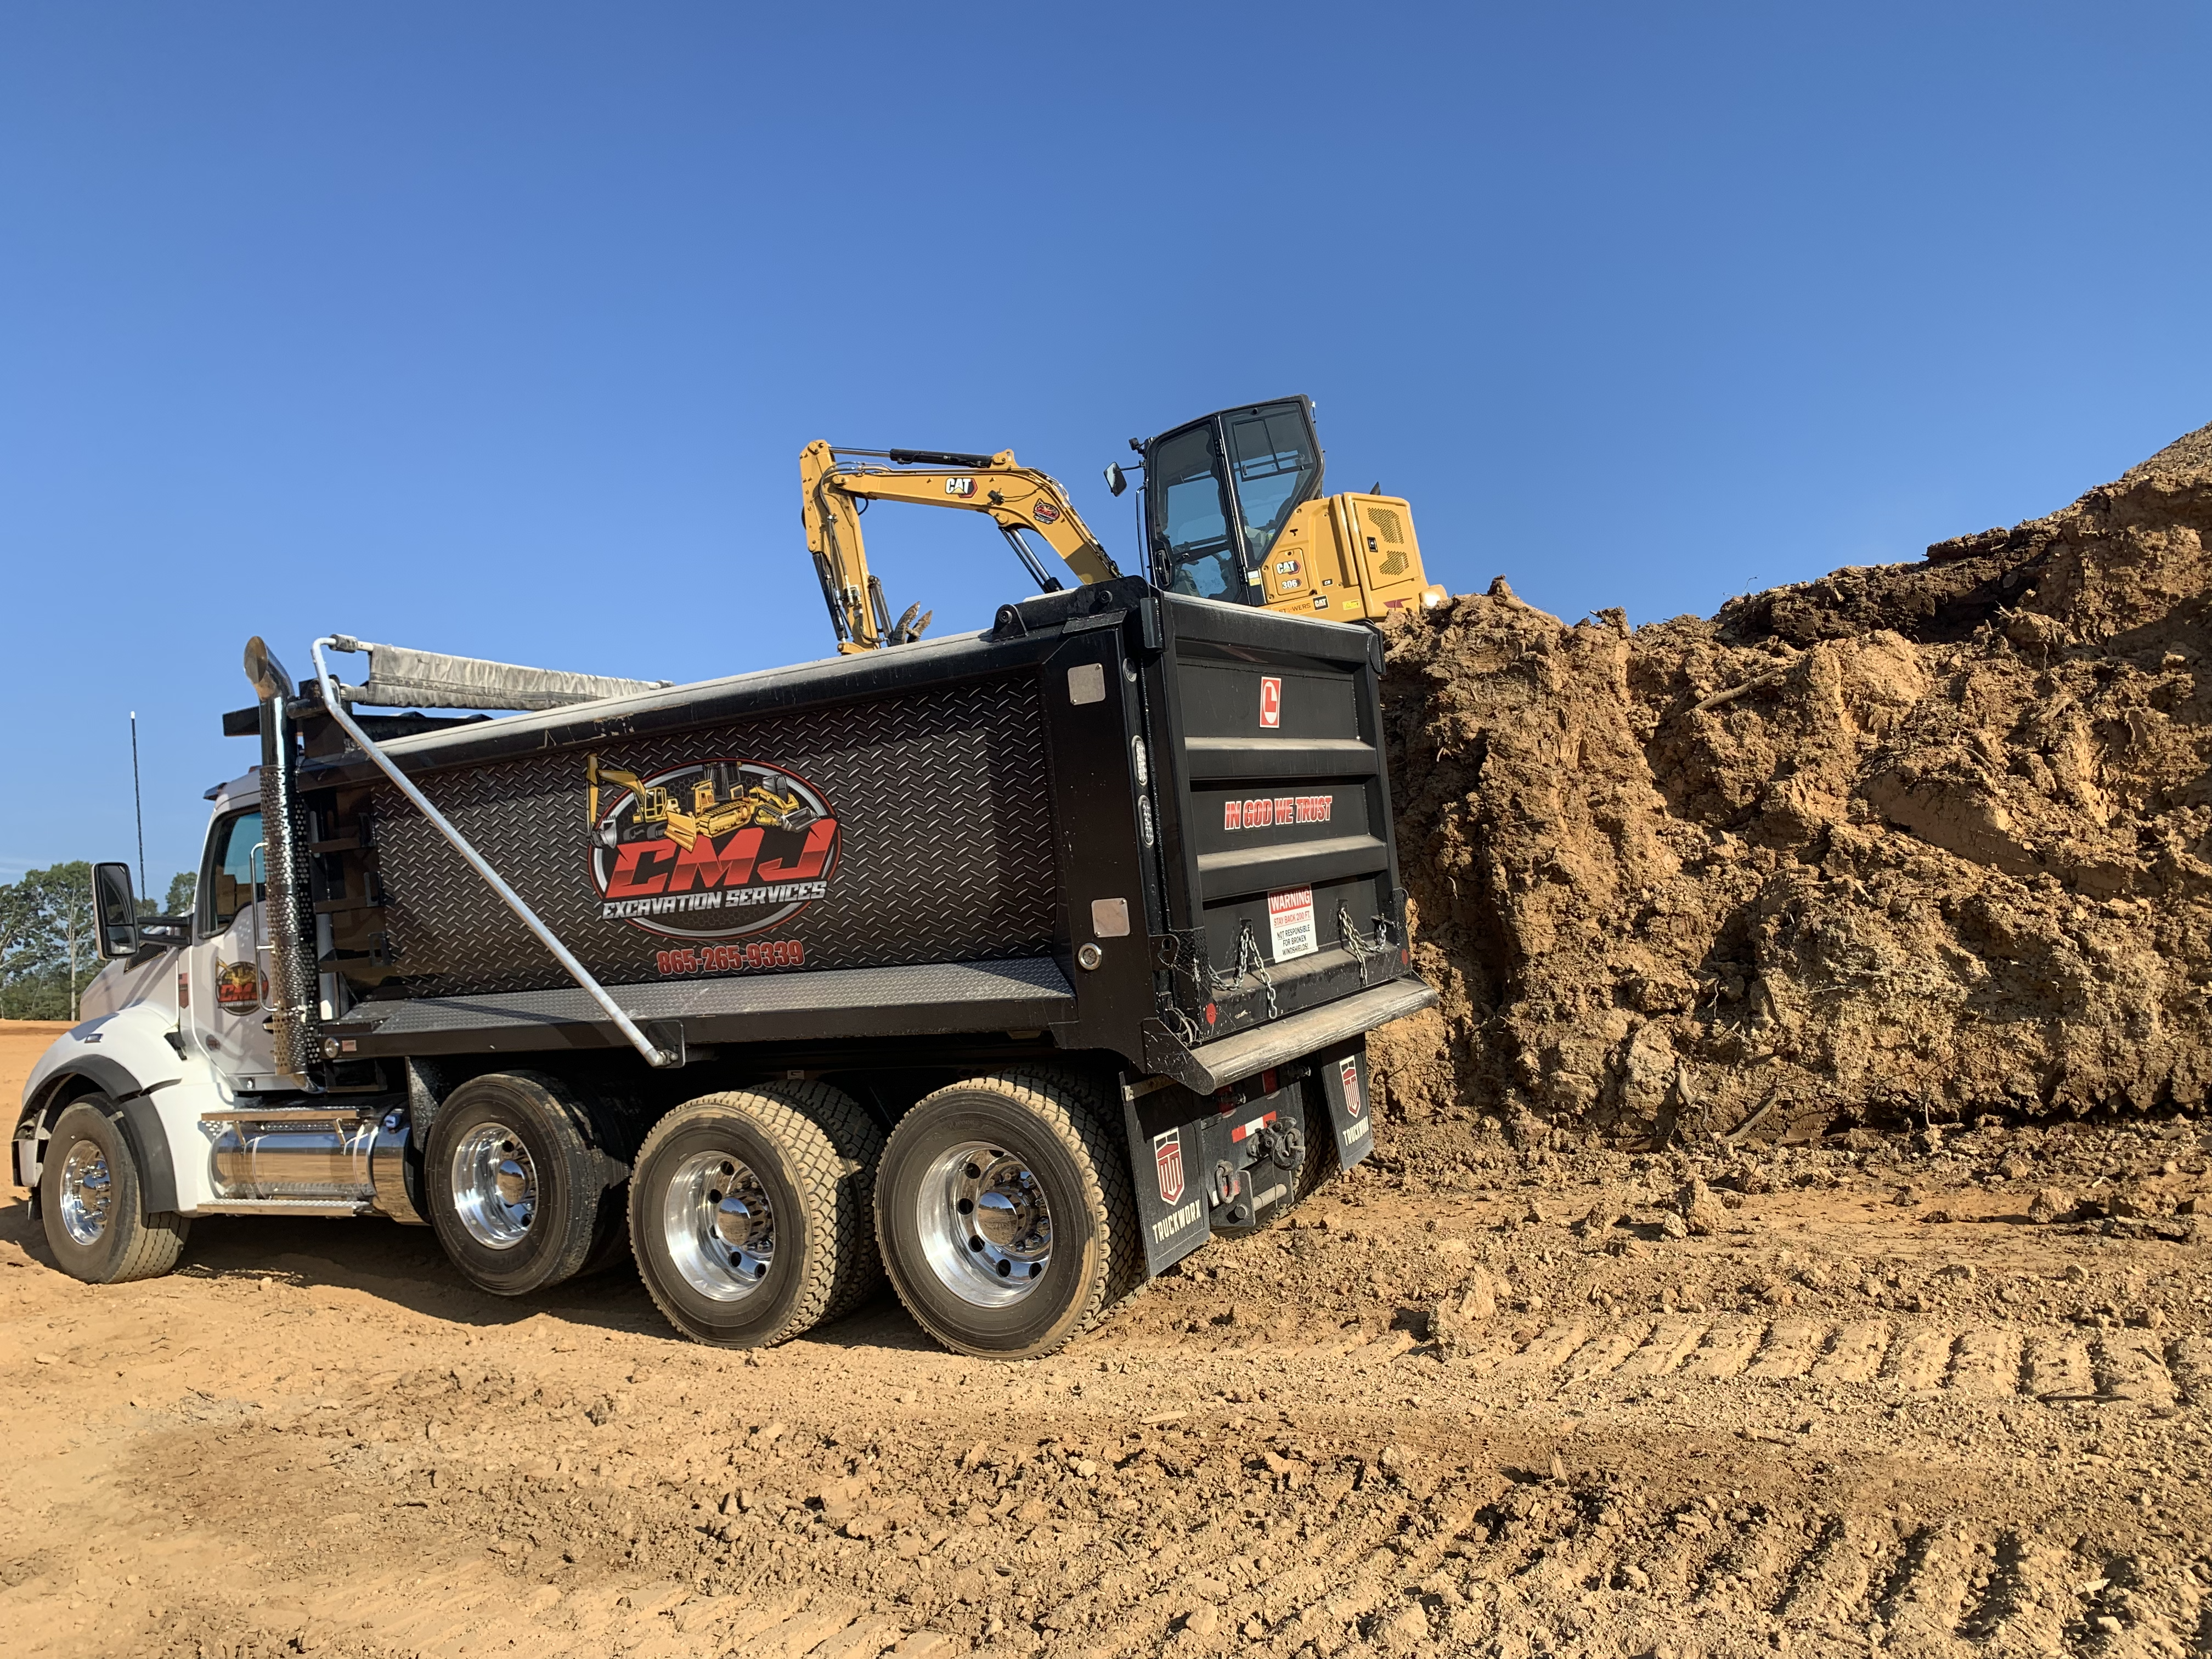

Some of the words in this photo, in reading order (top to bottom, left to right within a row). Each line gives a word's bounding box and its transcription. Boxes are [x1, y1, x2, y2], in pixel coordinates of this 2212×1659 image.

[945, 478, 972, 494] CAT
[1276, 560, 1295, 574] CAT
[1282, 579, 1297, 589] 306
[1314, 599, 1327, 607] CAT
[1265, 686, 1277, 713] L
[1224, 801, 1242, 830] IN
[1243, 799, 1273, 828] GOD
[1274, 797, 1294, 825] WE
[1295, 795, 1332, 823] TRUST
[606, 818, 838, 899] CMJ
[602, 891, 722, 919] EXCAVATION
[725, 881, 827, 907] SERVICES
[1271, 889, 1311, 911] WARNING
[1274, 916, 1285, 927] STAY
[1284, 913, 1296, 924] BACK
[1277, 930, 1285, 939] NOT
[1285, 924, 1310, 937] RESPONSIBLE
[1283, 938, 1291, 947] FOR
[1291, 934, 1307, 945] BROKEN
[656, 939, 805, 975] 865-265-9339
[1152, 1199, 1201, 1244] TRUCKWORX
